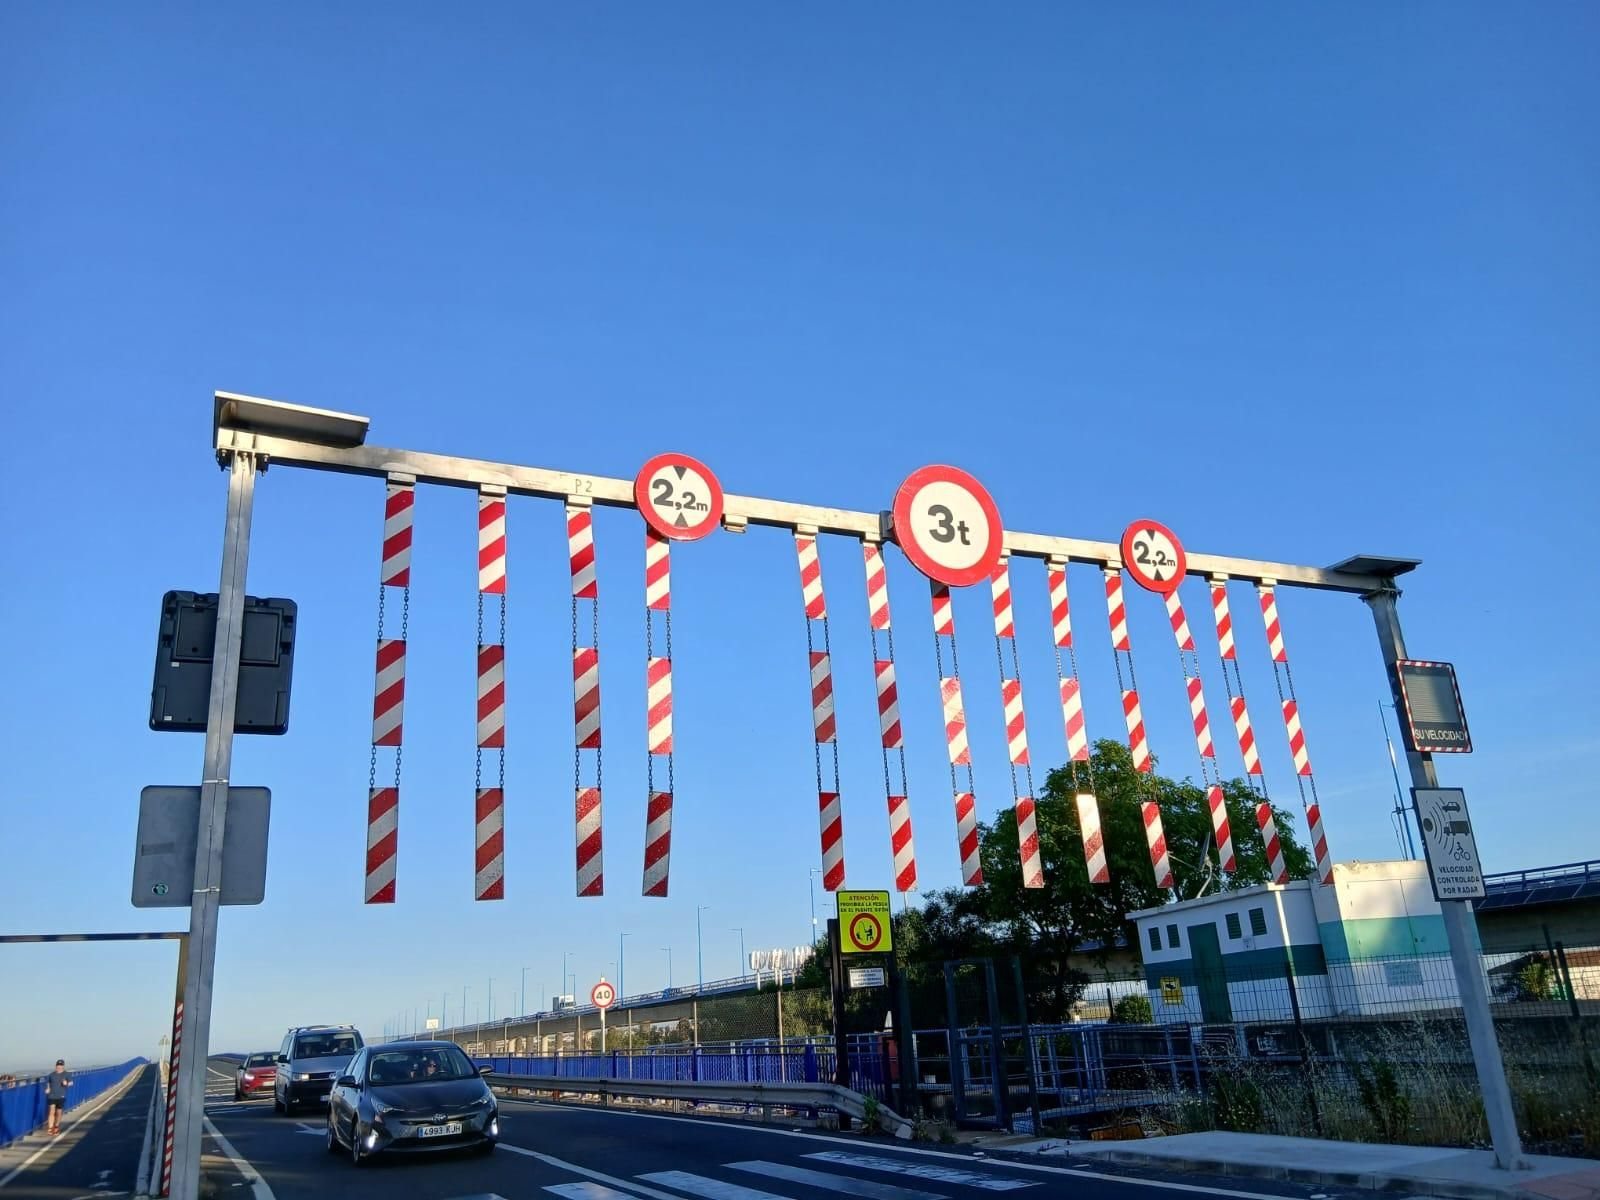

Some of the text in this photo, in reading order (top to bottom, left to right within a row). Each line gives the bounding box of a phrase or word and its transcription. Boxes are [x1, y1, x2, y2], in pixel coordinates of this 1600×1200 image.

[652, 478, 708, 512] 2,2m
[1133, 540, 1176, 567] 2,2m
[1414, 728, 1465, 741] SU VELOCIDAD
[1438, 865, 1474, 873] VELOCIDAD
[1437, 875, 1480, 884] CONTROLADA
[1457, 886, 1478, 894] RADAR
[849, 893, 880, 901] ATENCIÓN
[596, 990, 610, 999] 40
[424, 1127, 443, 1135] 4993
